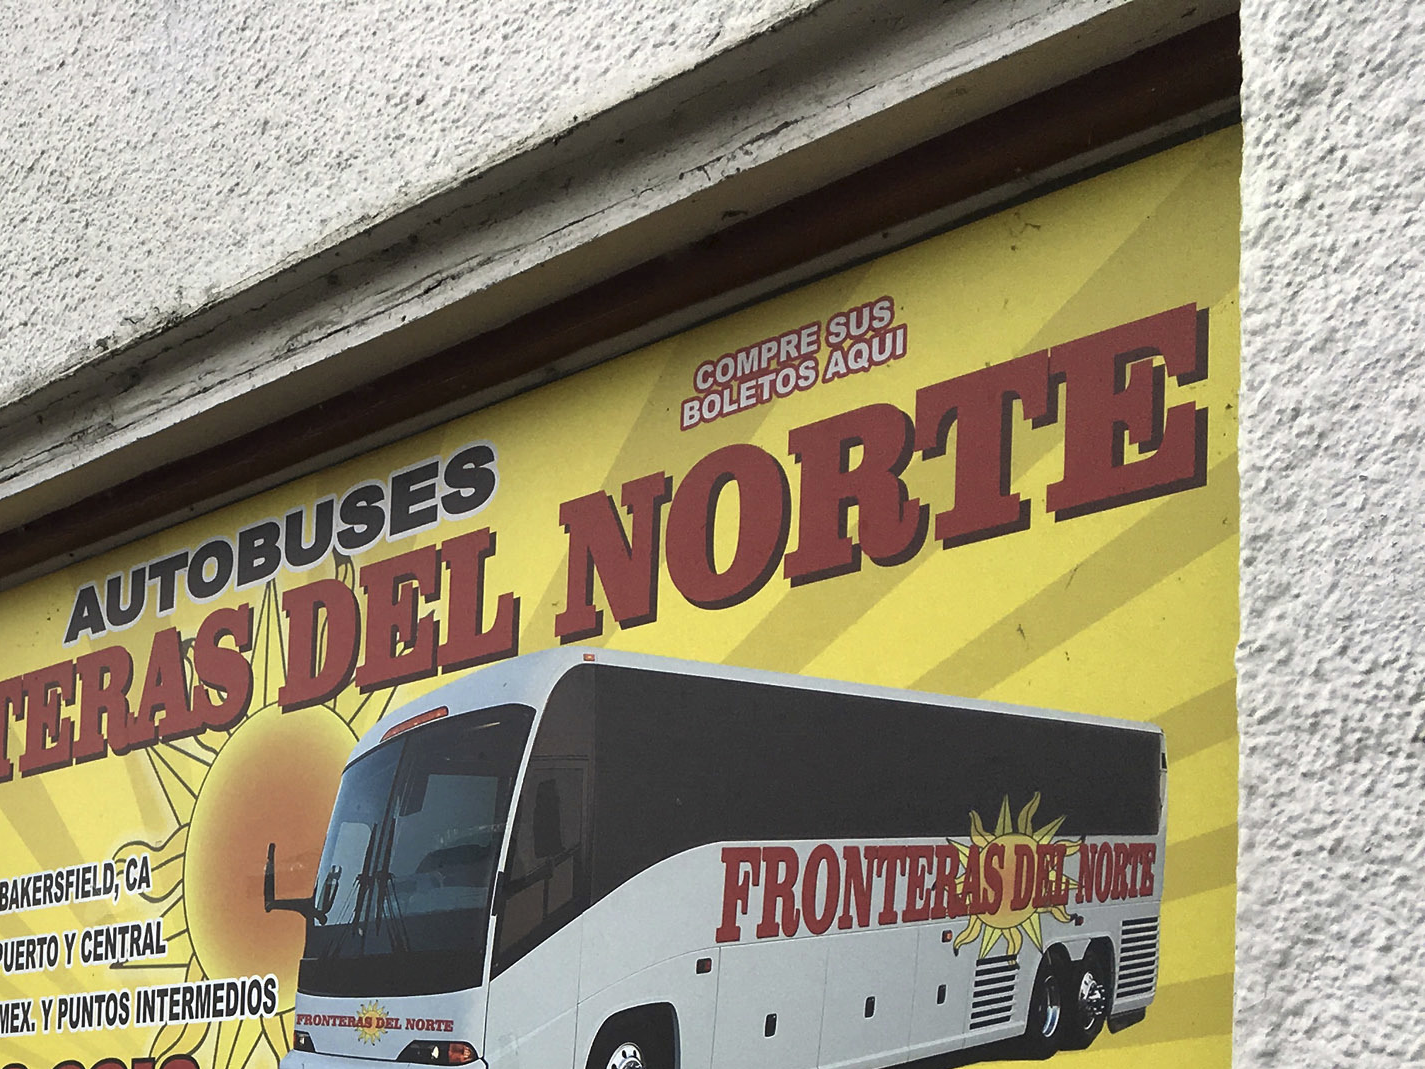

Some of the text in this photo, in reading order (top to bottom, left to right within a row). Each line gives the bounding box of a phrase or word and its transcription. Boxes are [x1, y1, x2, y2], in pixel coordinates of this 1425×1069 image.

[681, 325, 907, 430] BOLETOS AQUI
[694, 297, 895, 392] COMPRE SUS
[64, 443, 497, 645] AUTOBUSES
[278, 526, 520, 714] DEL
[554, 302, 1209, 645] NORTE
[124, 855, 151, 893] CA
[716, 842, 1156, 943] FRONTERAS DEL NORTE
[63, 932, 77, 966] Y
[81, 922, 167, 964] CENTRAL
[40, 995, 54, 1031] Y
[57, 990, 130, 1031] PUNTOS
[135, 976, 277, 1025] INTERMEDIOS
[296, 1013, 454, 1032] FRONTERAS DEL NORTE
